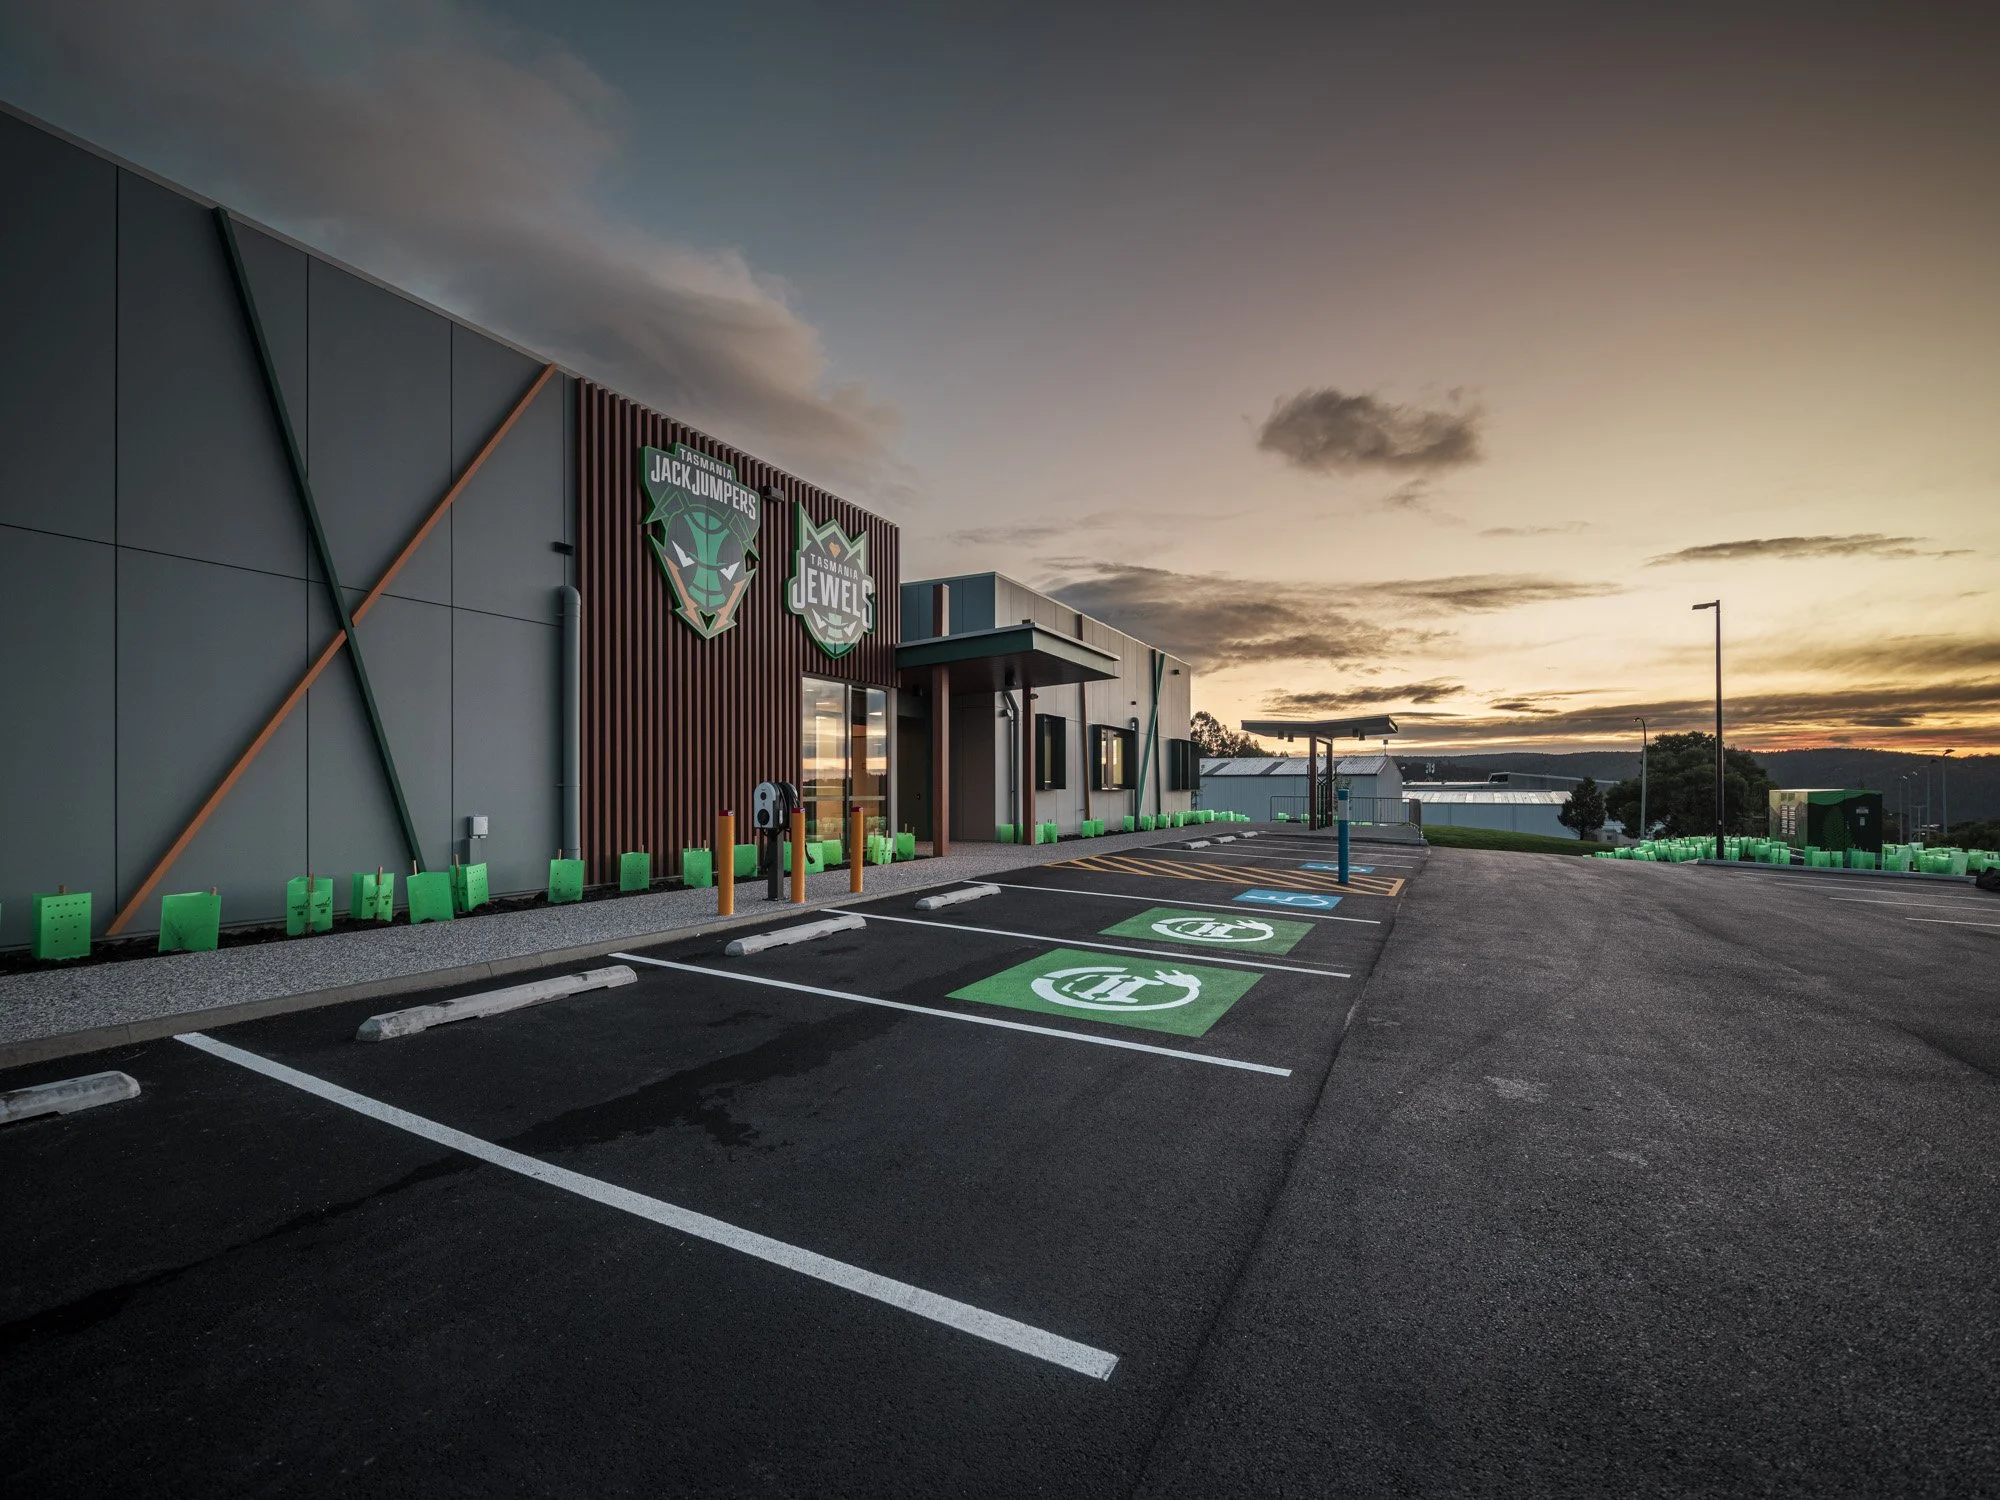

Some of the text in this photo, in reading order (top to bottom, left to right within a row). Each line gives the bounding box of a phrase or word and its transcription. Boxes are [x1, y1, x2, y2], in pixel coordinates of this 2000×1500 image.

[651, 455, 756, 520] JACKJUMPERS
[680, 448, 732, 480] TASMANIA
[810, 553, 858, 580] TASMANIA
[792, 557, 873, 629] JEWELS
